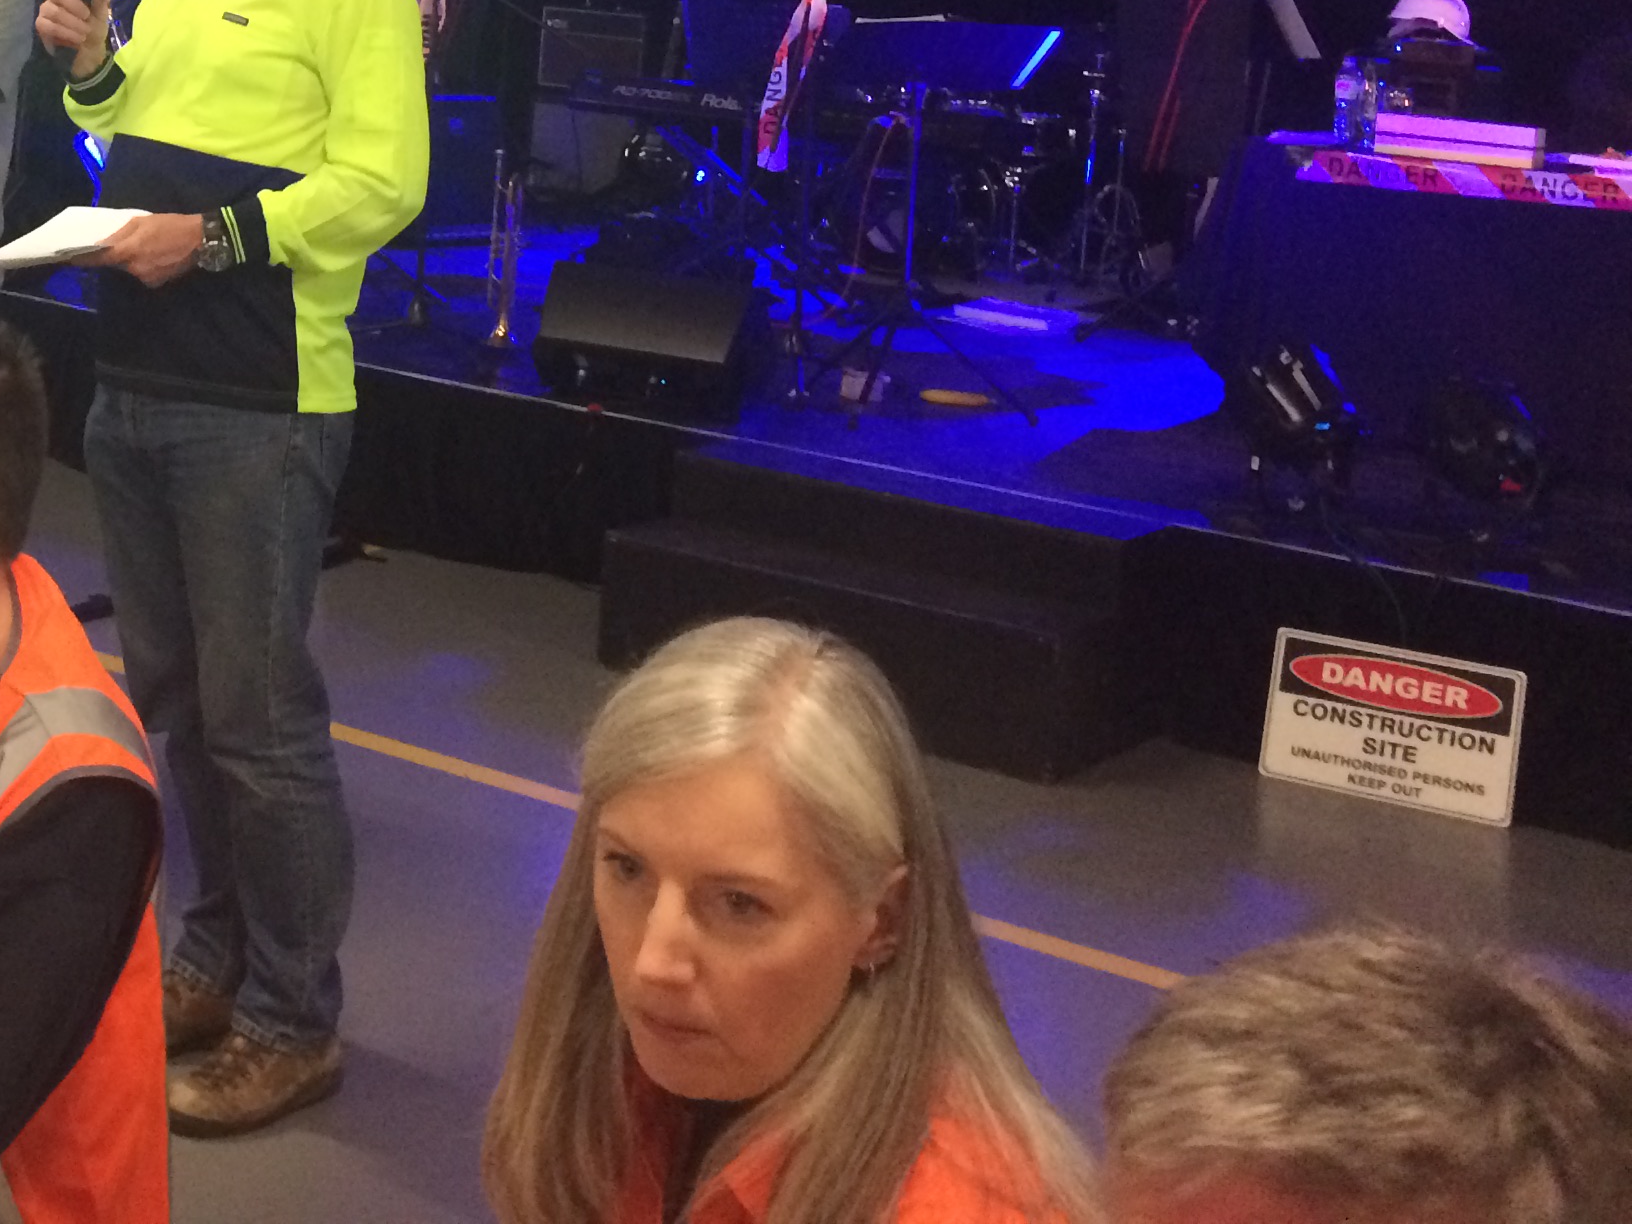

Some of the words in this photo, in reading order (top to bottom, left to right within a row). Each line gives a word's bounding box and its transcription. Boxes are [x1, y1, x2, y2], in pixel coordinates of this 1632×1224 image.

[1321, 661, 1470, 711] DANGER
[1292, 698, 1497, 756] CONSTRUCTION
[1361, 737, 1418, 764] SITE
[1291, 745, 1408, 781] UNAUTHORISED
[1412, 771, 1486, 797] PERSONS
[1346, 773, 1387, 792] KEEP
[1392, 782, 1423, 799] OUT
